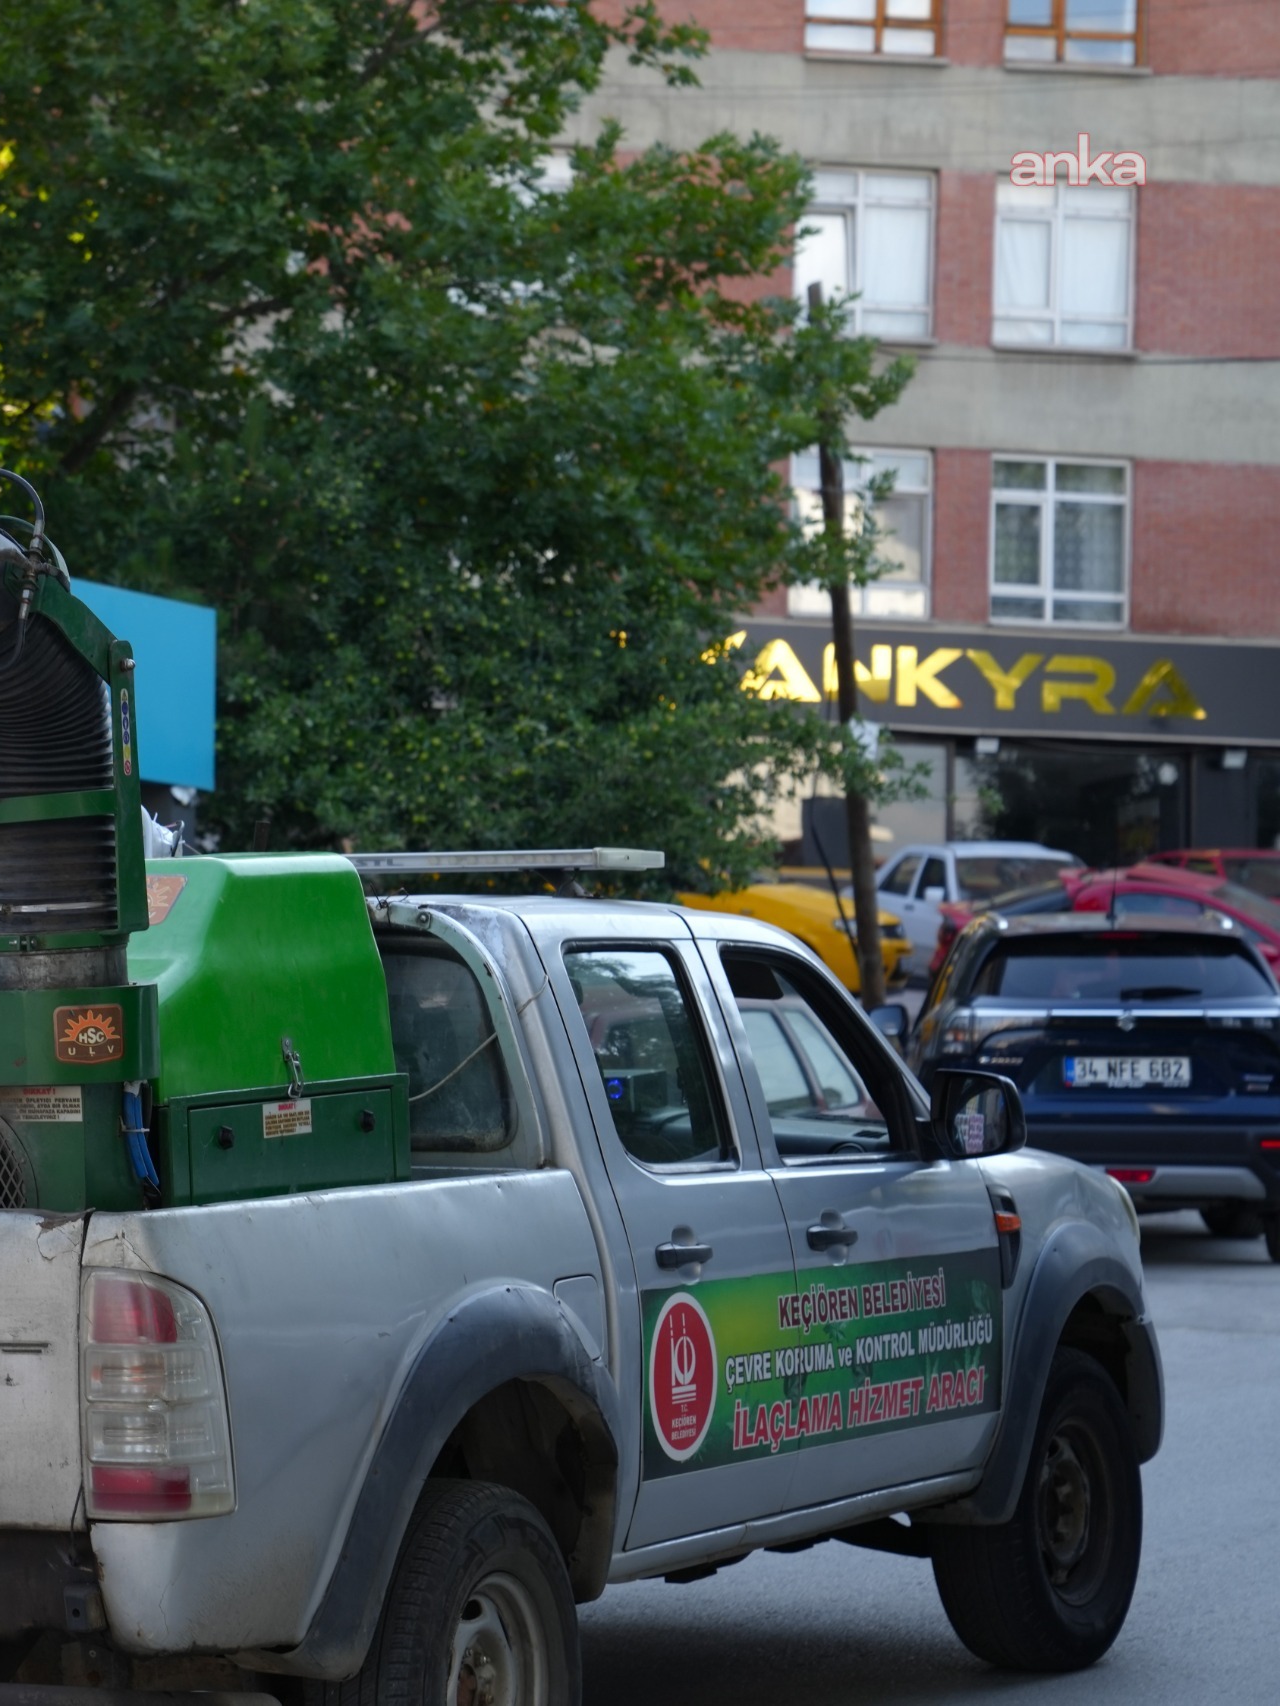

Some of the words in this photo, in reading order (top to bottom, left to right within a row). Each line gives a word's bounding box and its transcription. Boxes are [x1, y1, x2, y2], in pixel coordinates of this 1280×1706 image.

[79, 1028, 105, 1043] HSC
[1076, 1061, 1098, 1079] 34
[1107, 1061, 1141, 1079] NFE
[778, 1284, 860, 1334] KEÇİÖREN
[861, 1267, 946, 1318] BELEDİYESİ
[725, 1352, 772, 1393] ÇEVRE
[775, 1343, 835, 1379] KORUMA
[838, 1346, 853, 1368] ve
[856, 1331, 915, 1365] KONTROL
[918, 1313, 994, 1356] MÜDÜRLÜĞÜ
[733, 1399, 843, 1452] İLAÇLAMA
[847, 1377, 925, 1429] HİZMET
[926, 1366, 986, 1414] ARACI
